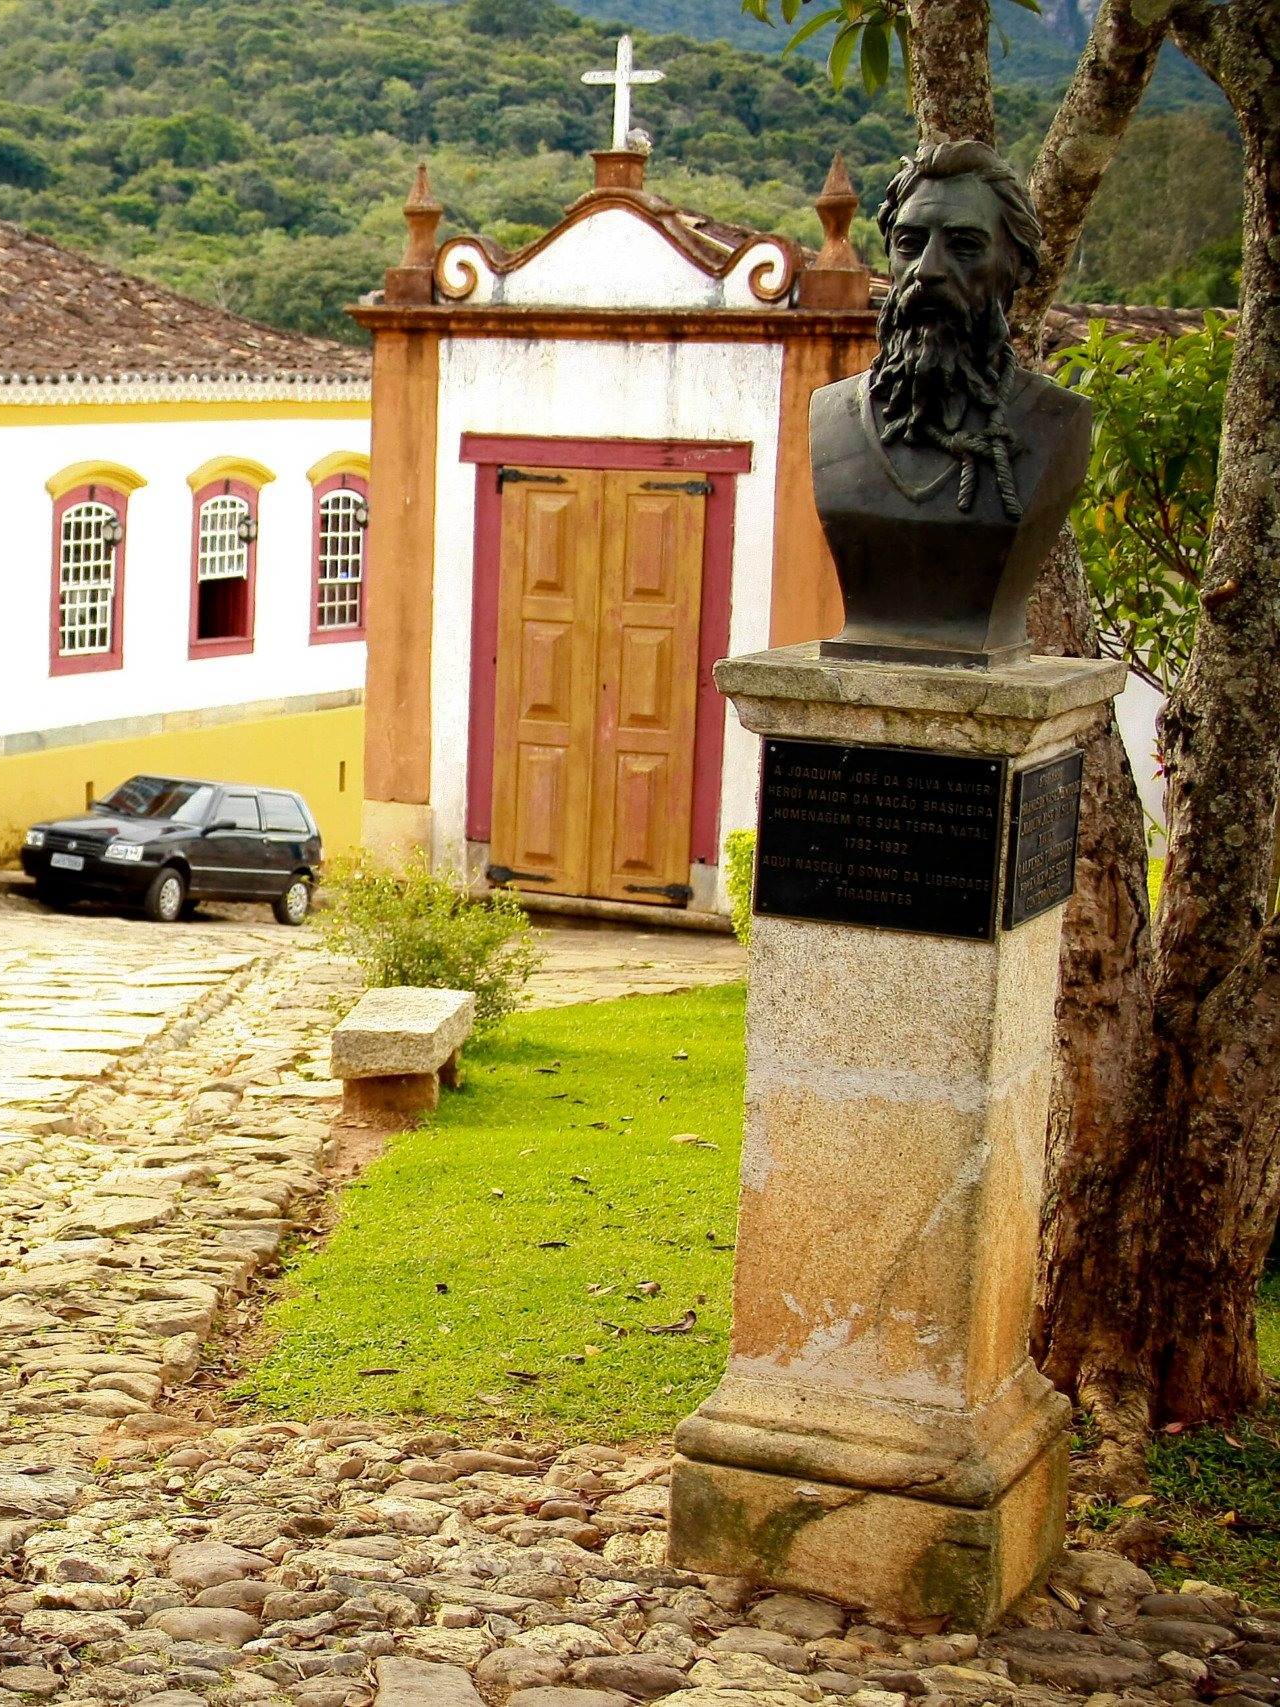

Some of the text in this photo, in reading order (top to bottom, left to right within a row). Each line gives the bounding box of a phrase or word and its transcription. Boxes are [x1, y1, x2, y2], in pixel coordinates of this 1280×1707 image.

[773, 764, 782, 777] A
[787, 766, 842, 781] JOAQUIM
[884, 775, 900, 788] DA
[906, 776, 940, 791] SILVA
[808, 788, 847, 803] MAIOR
[853, 793, 869, 805] DA
[923, 800, 993, 818] BRASILEIRA
[774, 808, 989, 841] HOMENAGEM DE SUA TERRA NATAL
[762, 855, 991, 892] AQUI NASCEU O SONHO DA LIBERDADE
[835, 886, 913, 906] TIRADENTES
